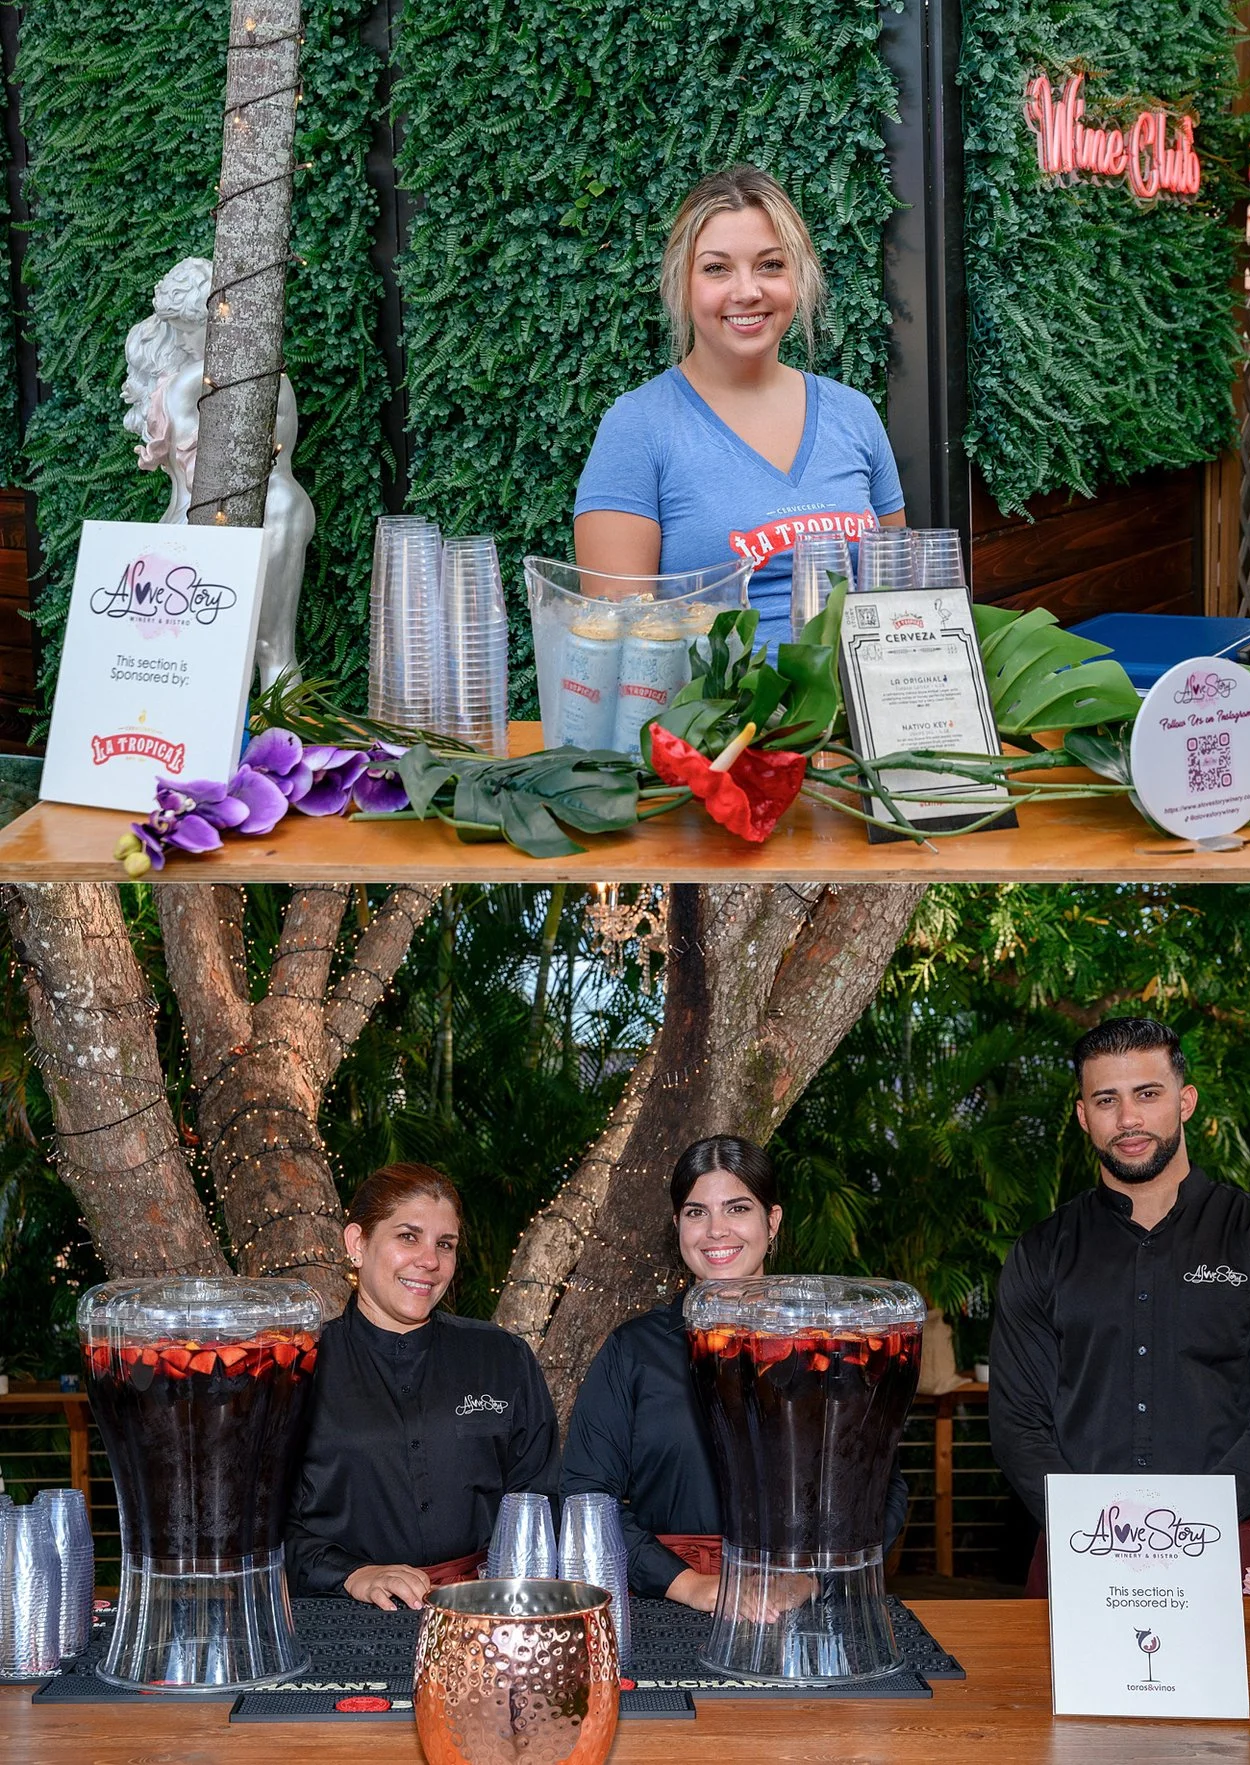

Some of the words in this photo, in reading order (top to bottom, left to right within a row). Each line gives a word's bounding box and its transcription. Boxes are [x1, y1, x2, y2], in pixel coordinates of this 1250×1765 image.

[1027, 73, 1128, 175] Wine
[1128, 111, 1200, 198] Club
[777, 502, 826, 514] CERVECERÍA
[734, 531, 774, 566] LA
[90, 563, 128, 614] A
[164, 566, 237, 625] Story
[885, 632, 937, 643] CERVEZA
[116, 654, 135, 668] This
[137, 657, 178, 671] section
[179, 660, 188, 672] is
[110, 667, 169, 684] Sponsored
[171, 673, 190, 688] by:
[903, 675, 942, 685] ORIGINAL
[1205, 673, 1237, 698] Story
[902, 722, 931, 731] NATIVO
[933, 721, 947, 729] KEY
[1159, 717, 1186, 731] Follow
[1187, 713, 1204, 727] Us
[1205, 716, 1214, 724] on
[93, 737, 114, 763] LA
[117, 737, 184, 772] TROPICAL
[1215, 1265, 1248, 1287] Story
[1069, 1509, 1109, 1553] A
[1144, 1509, 1221, 1557] Story
[1109, 1586, 1129, 1597] This
[1132, 1586, 1174, 1597] section
[1177, 1587, 1185, 1597] is
[1105, 1597, 1168, 1609] Sponsored
[1170, 1597, 1189, 1610] by:
[1127, 1683, 1176, 1692] toros&vinos
